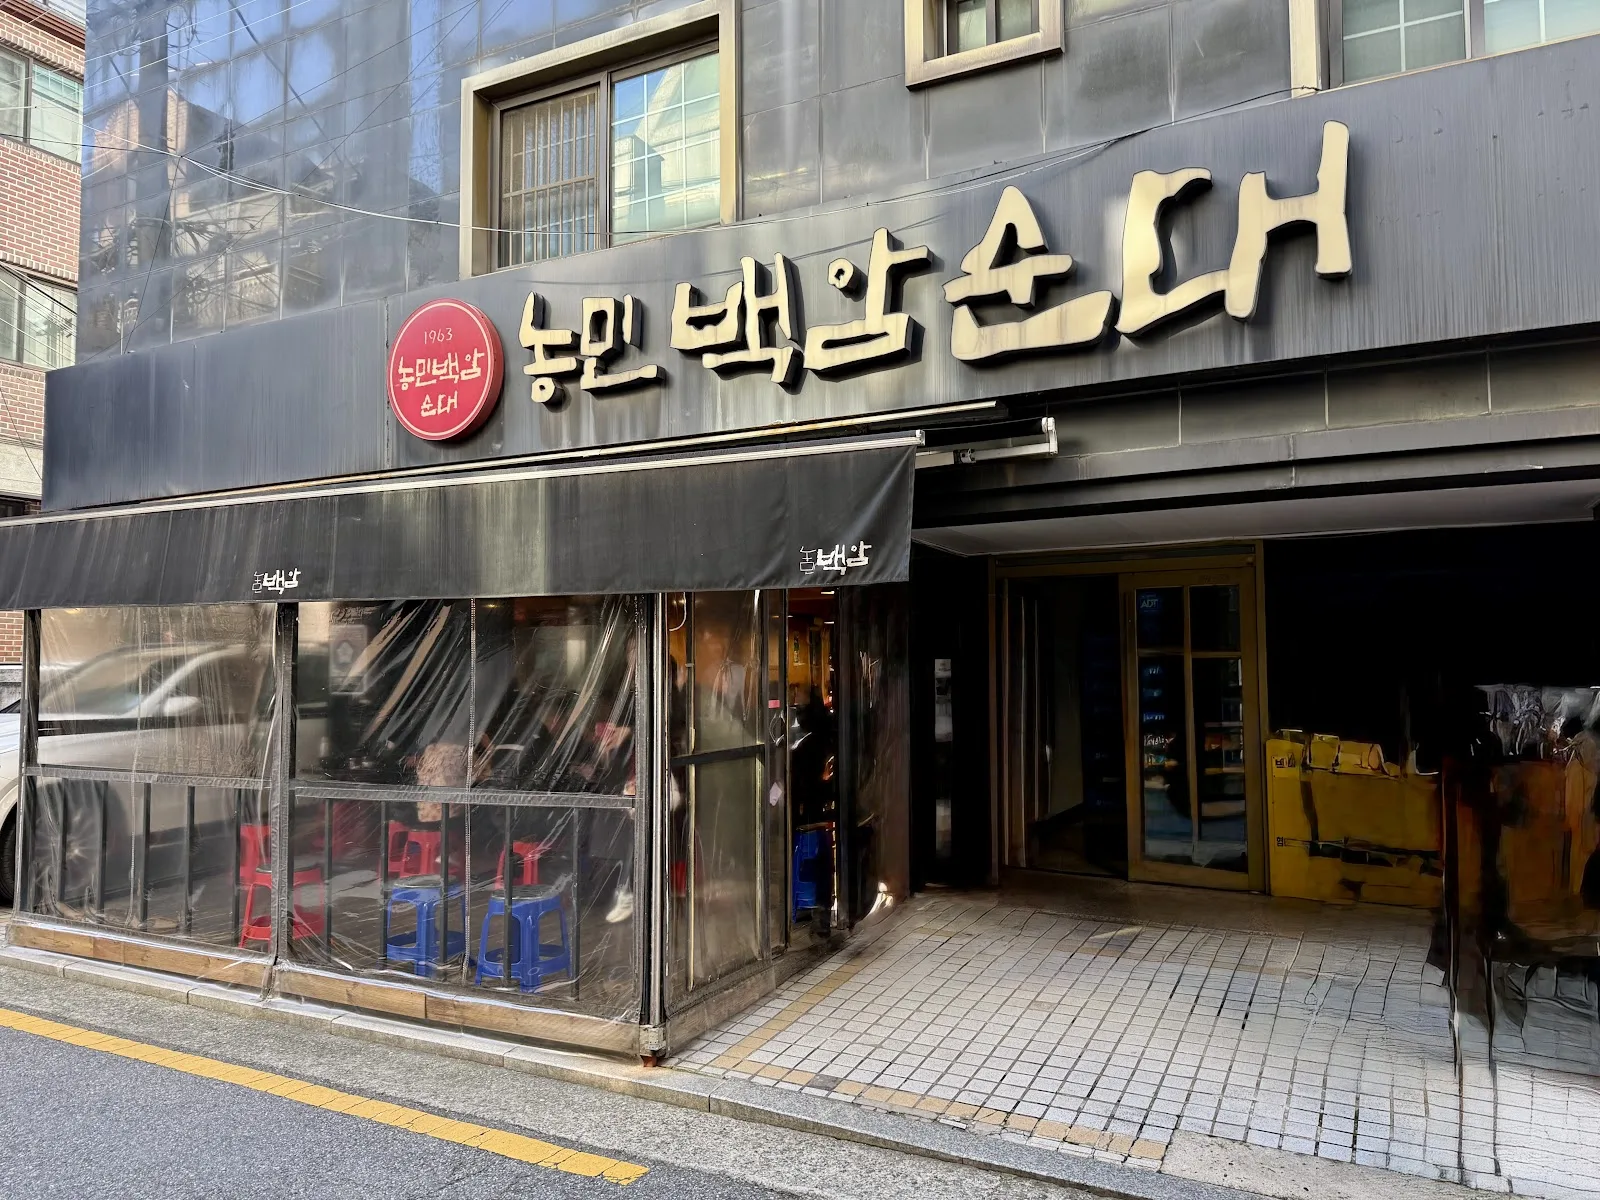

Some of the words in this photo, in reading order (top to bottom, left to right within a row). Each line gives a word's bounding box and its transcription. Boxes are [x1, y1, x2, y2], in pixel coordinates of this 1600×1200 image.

[424, 327, 453, 345] 1963
[420, 390, 458, 418] 순대
[1140, 598, 1158, 609] ADT
